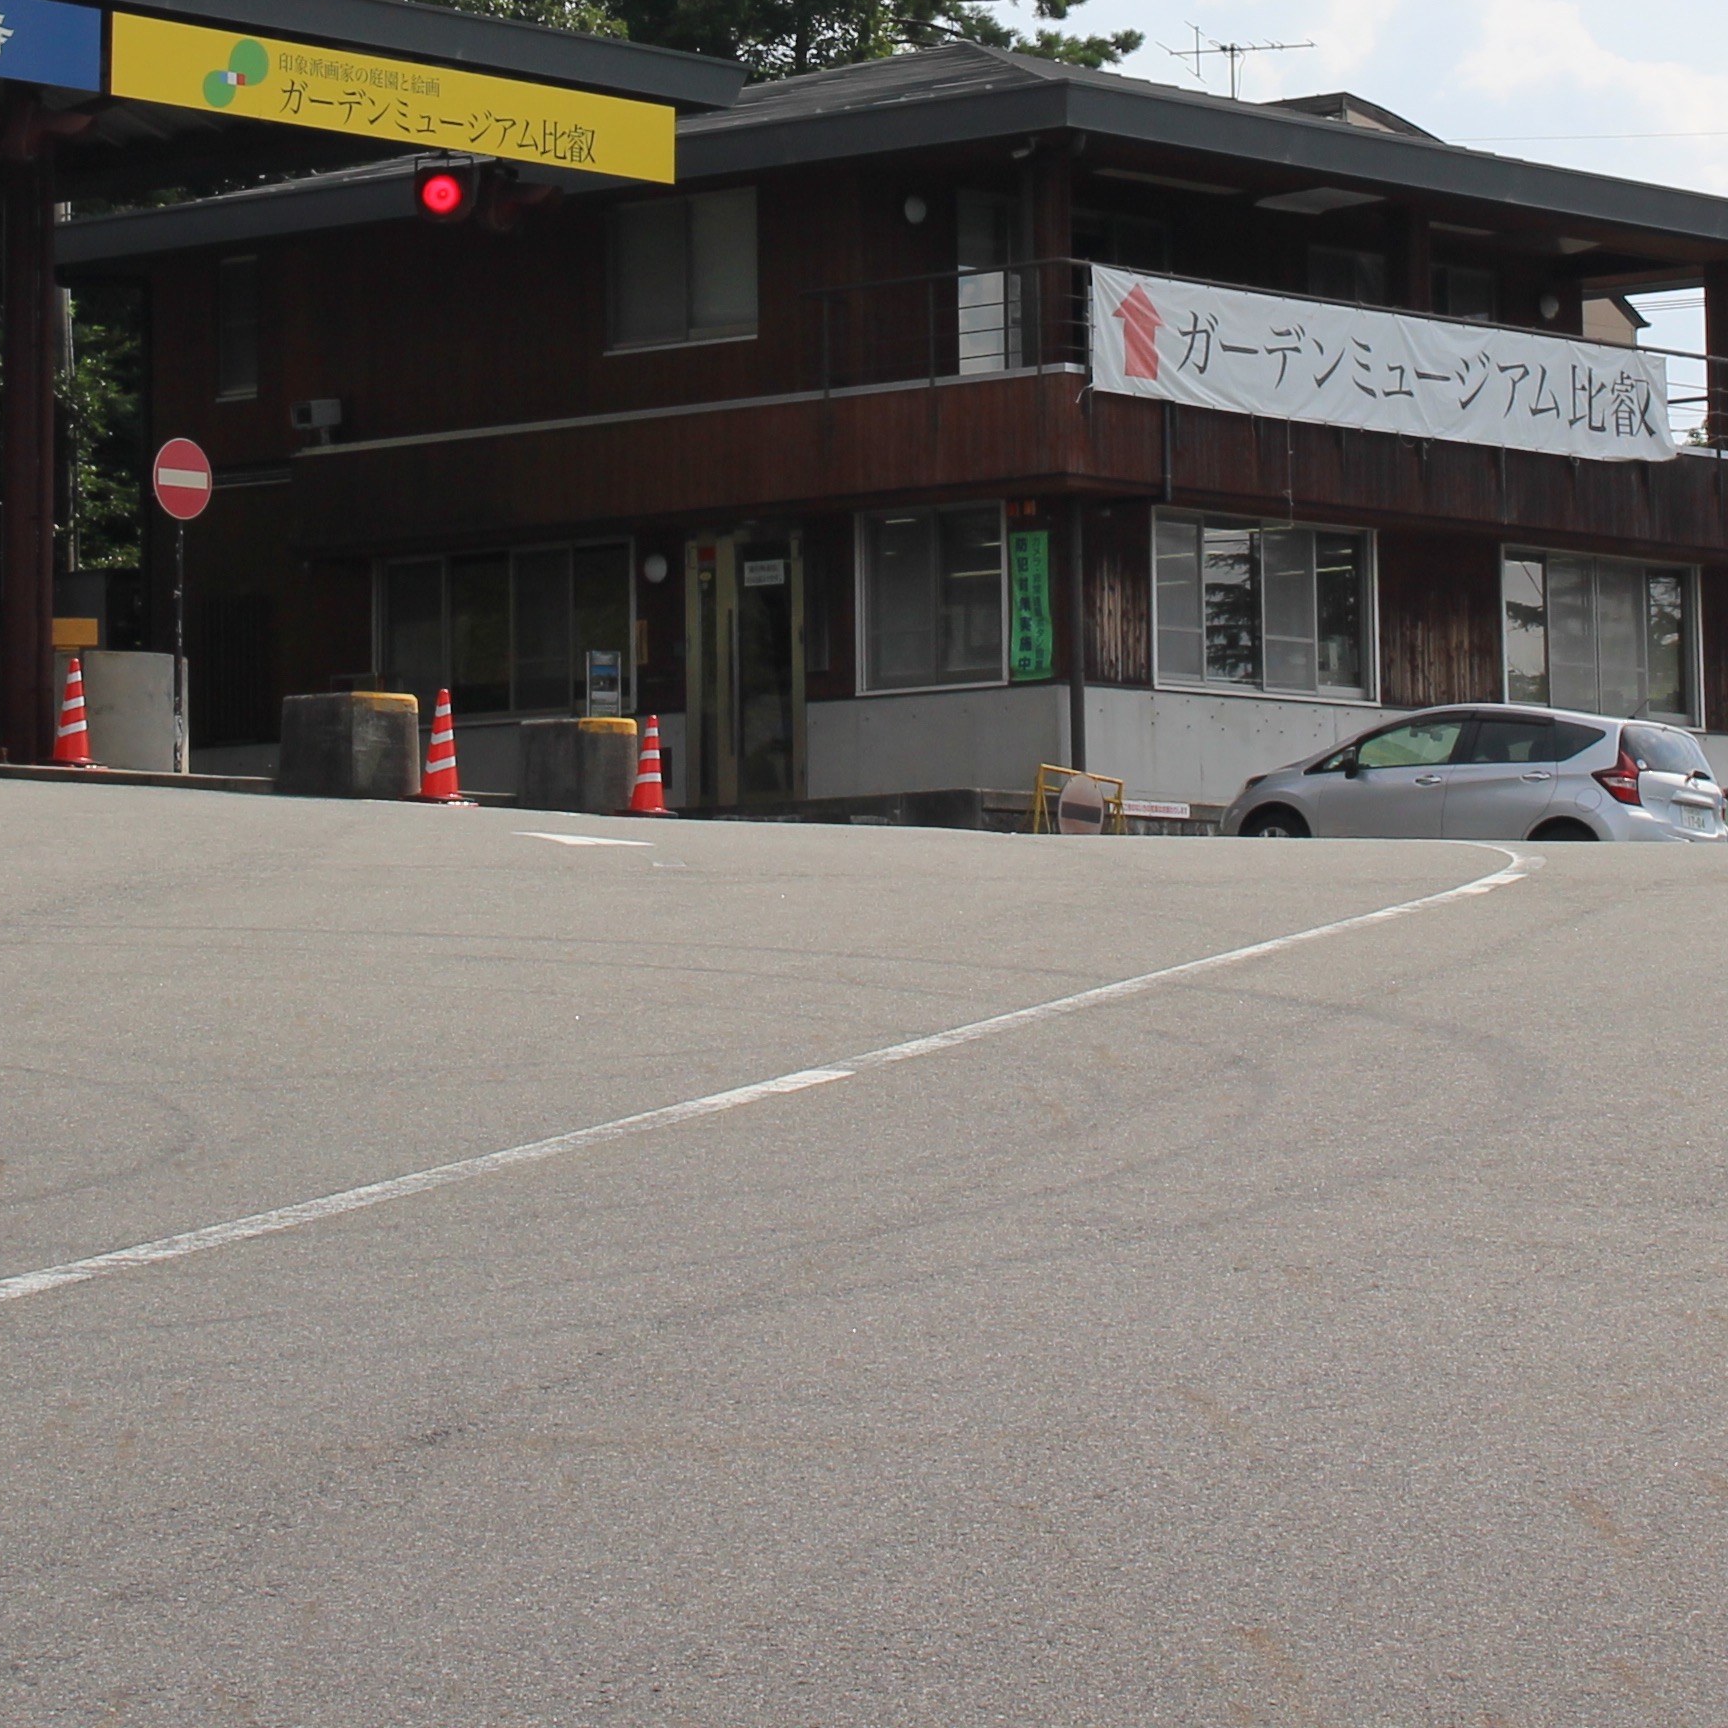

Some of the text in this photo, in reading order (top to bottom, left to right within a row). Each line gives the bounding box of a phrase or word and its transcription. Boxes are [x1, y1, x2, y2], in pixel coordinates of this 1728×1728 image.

[277, 52, 441, 99] 印象派画家の庭園と絵画
[279, 78, 597, 164] ガーデンミュージアム比叡
[1175, 309, 1659, 440] ガーデンミュージアム比叡
